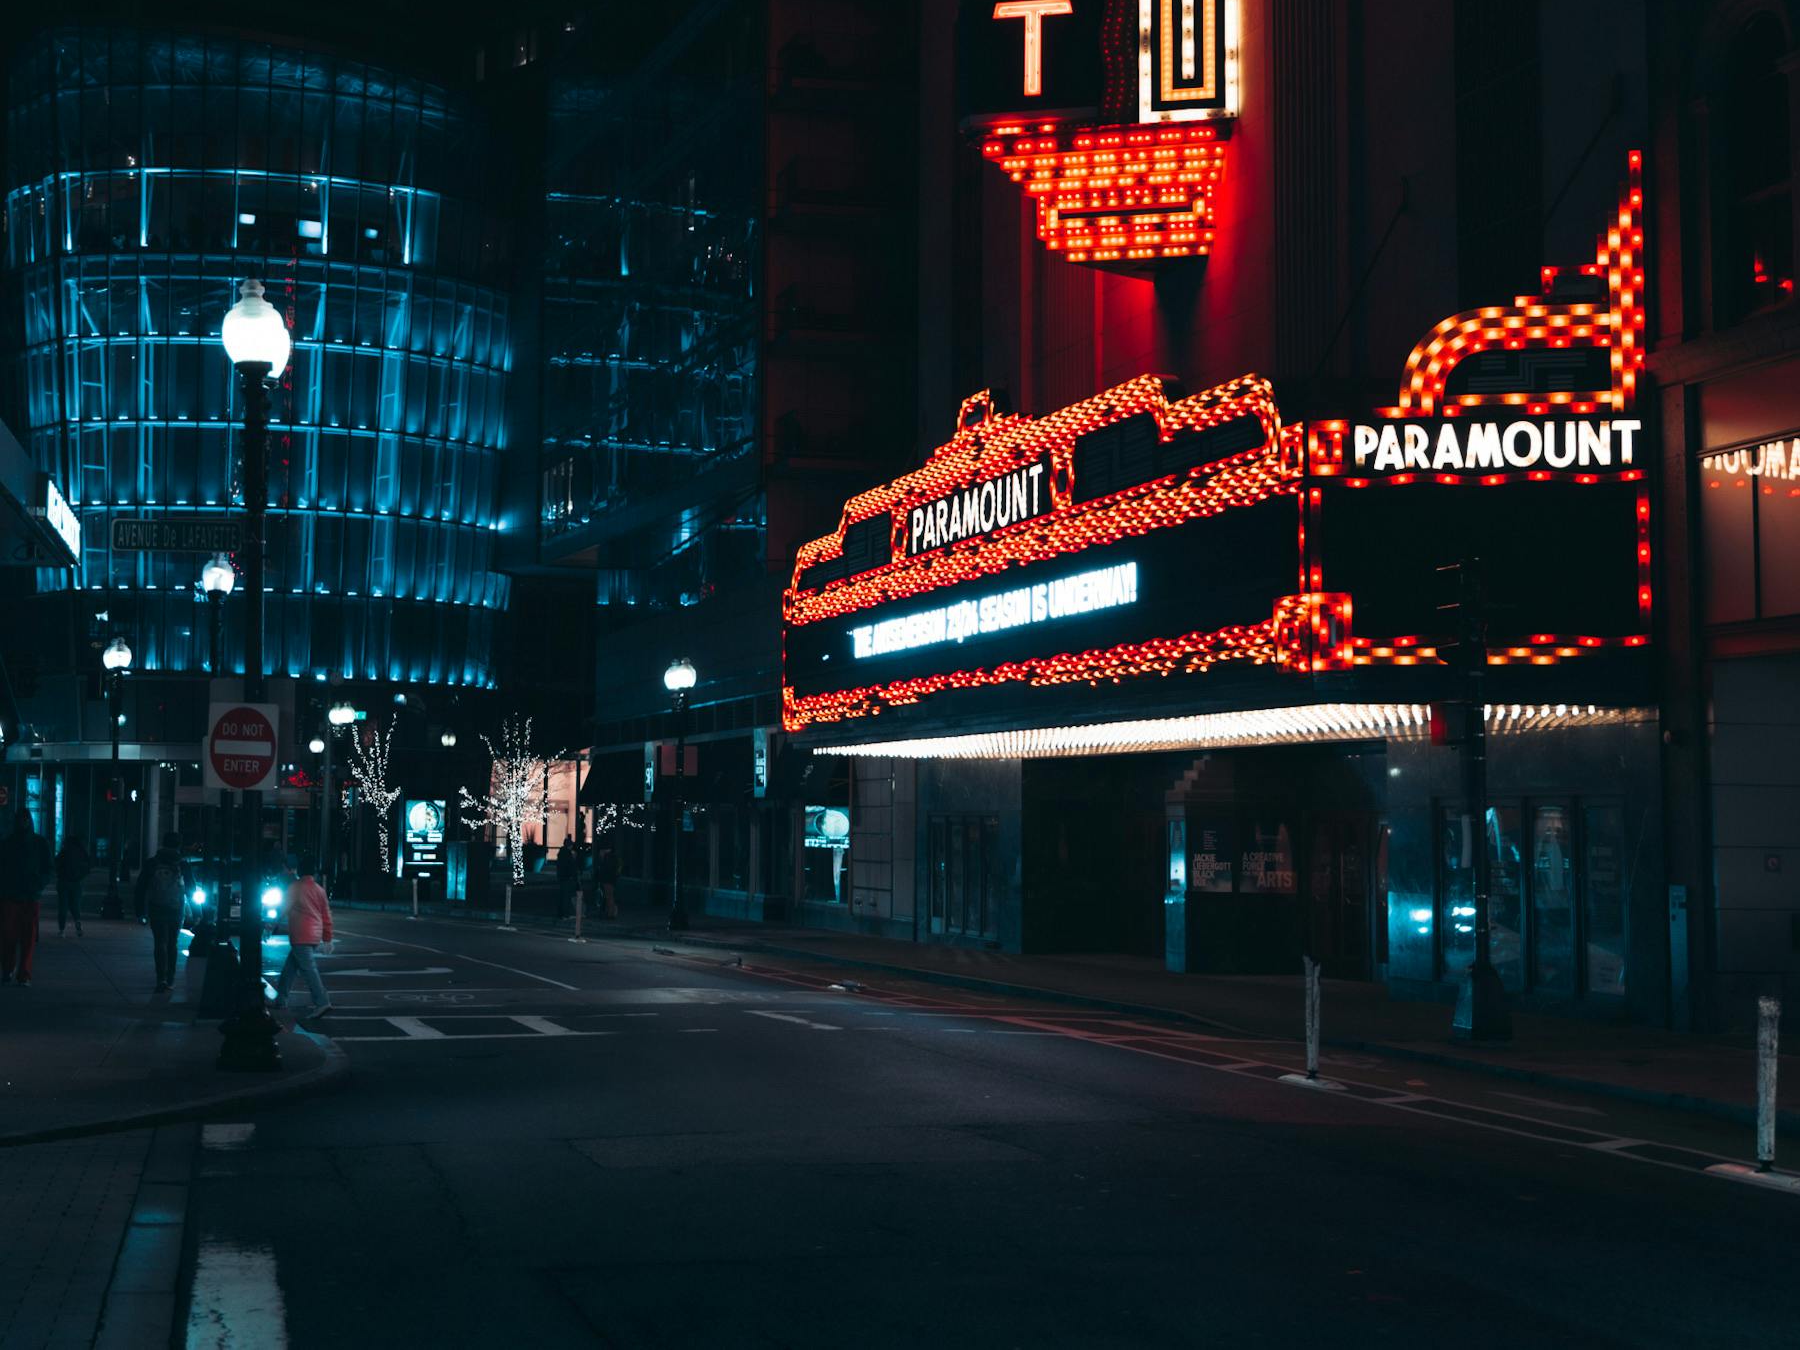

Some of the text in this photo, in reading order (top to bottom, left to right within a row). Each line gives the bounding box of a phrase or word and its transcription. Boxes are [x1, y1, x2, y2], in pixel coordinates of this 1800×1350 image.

[1354, 418, 1642, 471] PARAMOUNT
[911, 463, 1044, 554] PARAMOUNT
[117, 523, 159, 547] AVENUE
[182, 525, 238, 549] LAFAYETTE
[978, 586, 1031, 634] SEASON
[1032, 582, 1048, 623] IS
[222, 722, 264, 737] DO NOT
[223, 758, 260, 774] ENTER
[1256, 871, 1292, 888] ARTS
